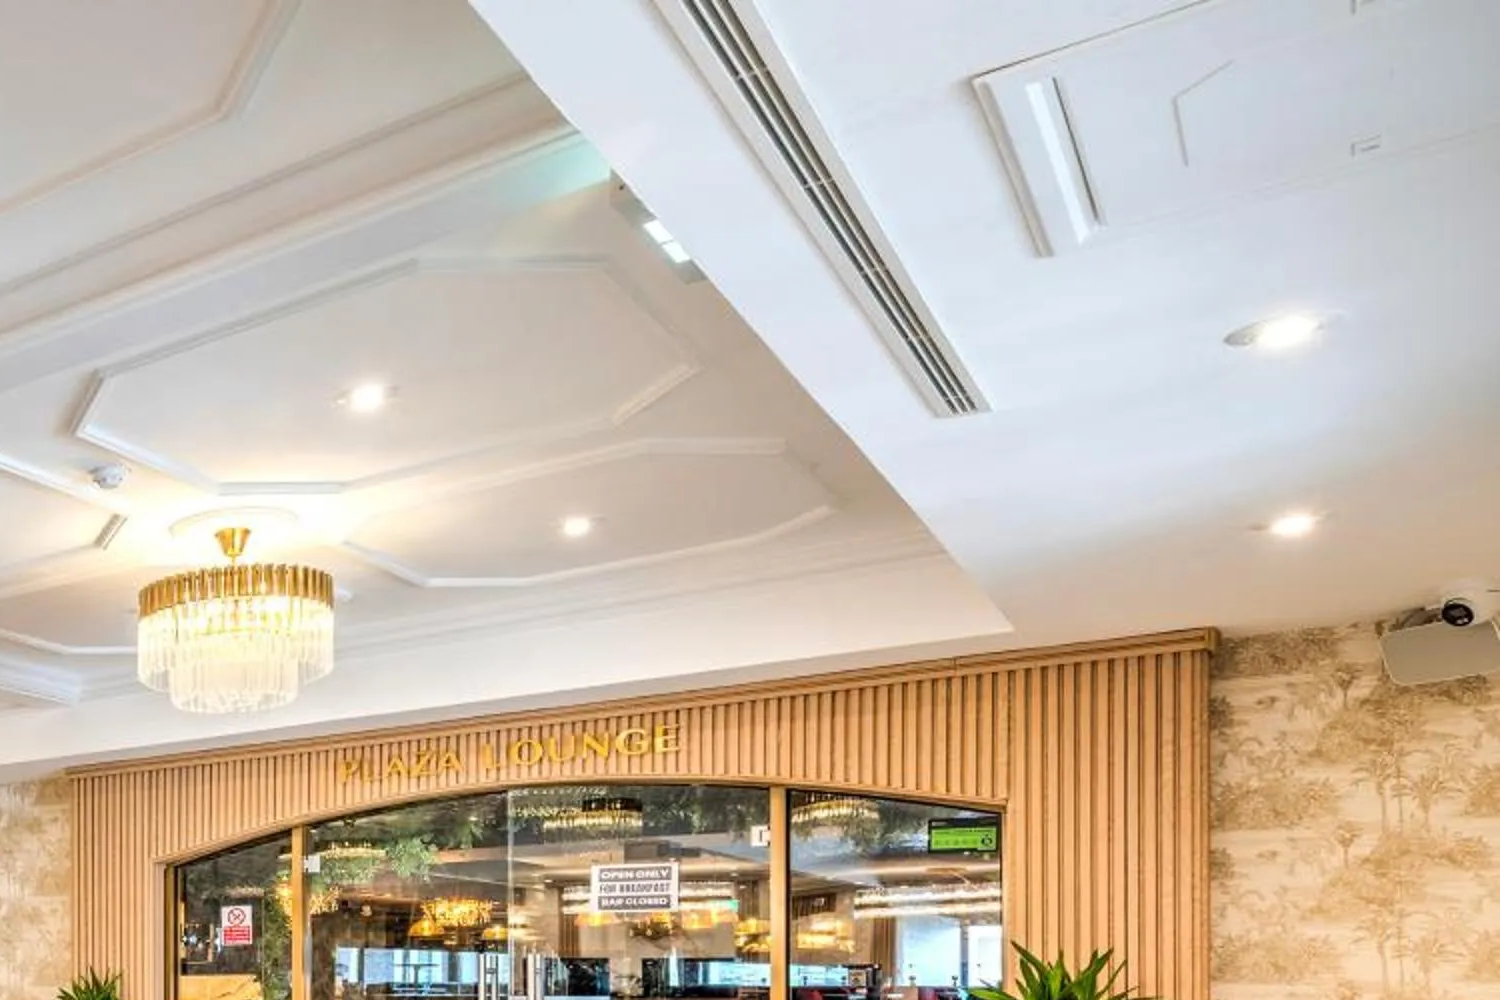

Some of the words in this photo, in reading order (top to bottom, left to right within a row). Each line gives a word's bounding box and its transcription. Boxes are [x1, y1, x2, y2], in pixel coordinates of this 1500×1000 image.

[340, 749, 464, 784] PLAZA
[483, 722, 682, 771] LOUNGE
[601, 870, 634, 880] OPEN
[635, 868, 669, 879] ONLY
